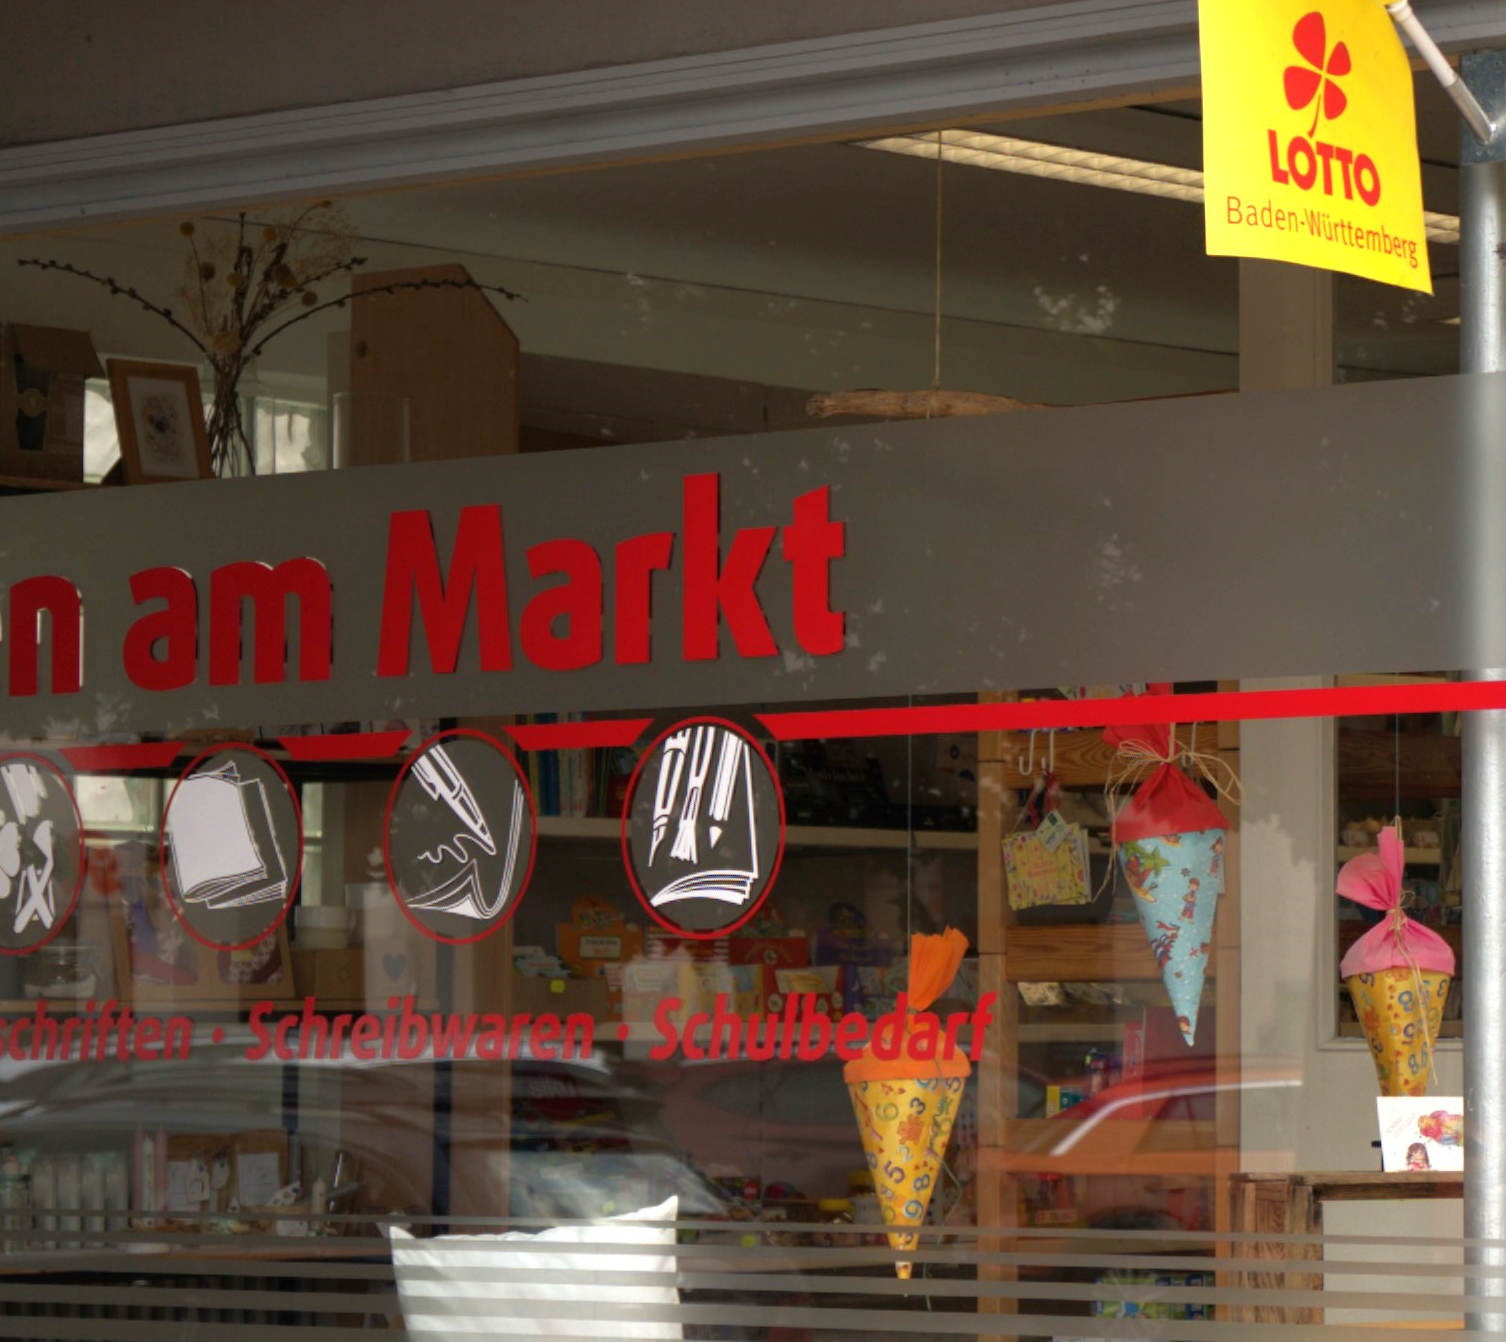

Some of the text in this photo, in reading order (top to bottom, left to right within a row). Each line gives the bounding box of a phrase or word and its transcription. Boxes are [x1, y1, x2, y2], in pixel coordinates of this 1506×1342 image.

[1267, 129, 1382, 208] LOTTO
[1225, 196, 1418, 270] Baden-Württemberg
[123, 555, 335, 693] am
[376, 472, 846, 678] Markt
[244, 996, 595, 1062] Schreibwaren
[649, 992, 997, 1062] Schulbedarf
